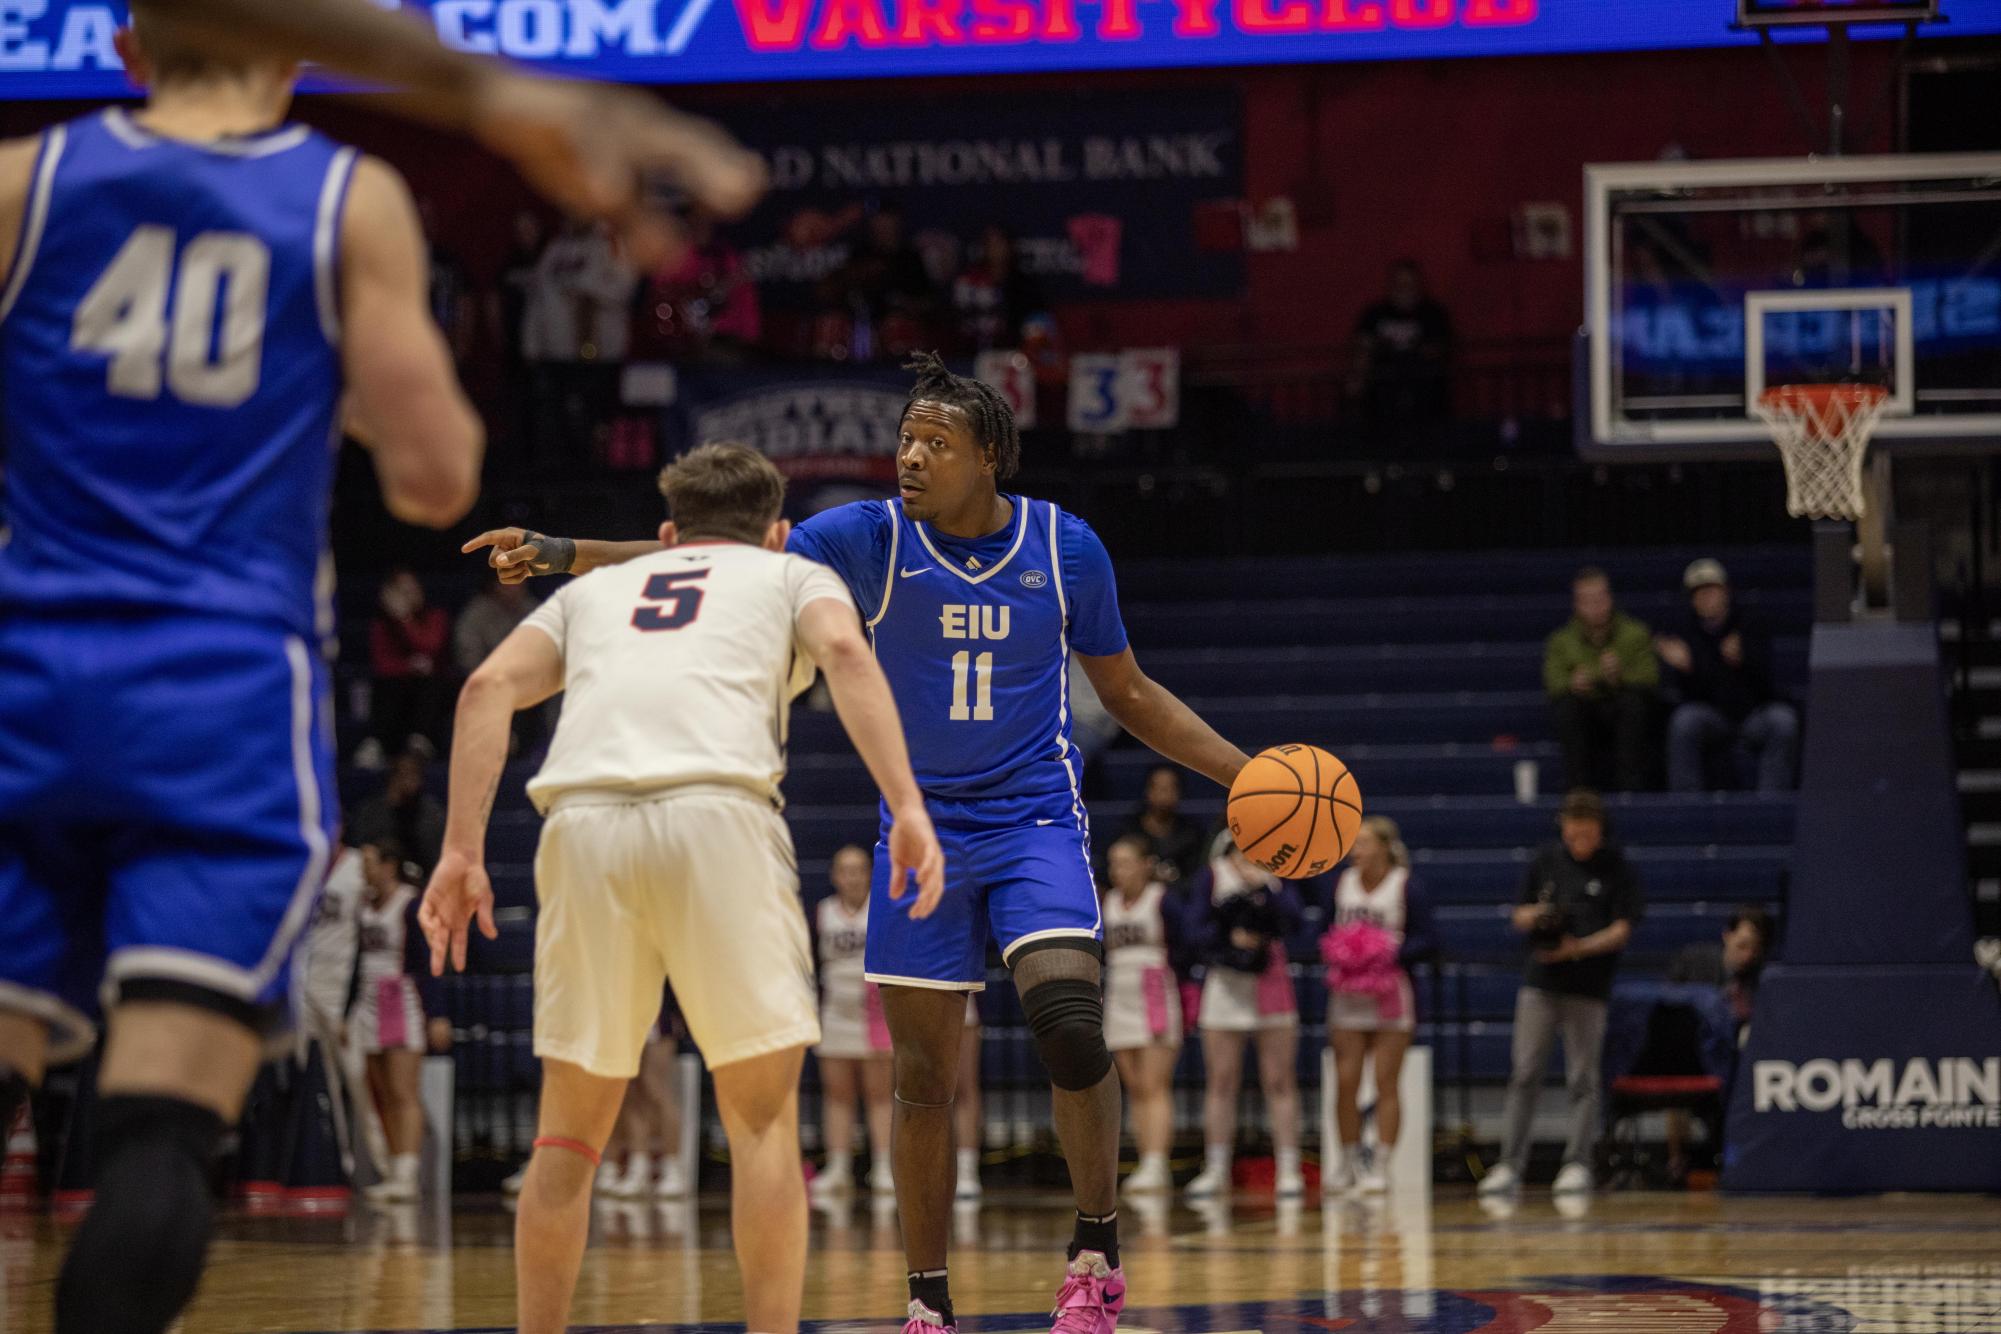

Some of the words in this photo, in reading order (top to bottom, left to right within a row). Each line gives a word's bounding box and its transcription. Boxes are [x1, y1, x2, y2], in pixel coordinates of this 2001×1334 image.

[820, 138, 1078, 188] NATIONAL
[1082, 131, 1226, 180] BANK
[71, 223, 269, 406] 40
[630, 567, 712, 633] 5
[1025, 575, 1041, 583] OVC
[938, 604, 1010, 640] EIU
[950, 650, 994, 720] 11
[1752, 1056, 2001, 1113] ROMAIN
[1842, 1105, 1917, 1129] CROSS
[1919, 1102, 2001, 1128] POINTE
